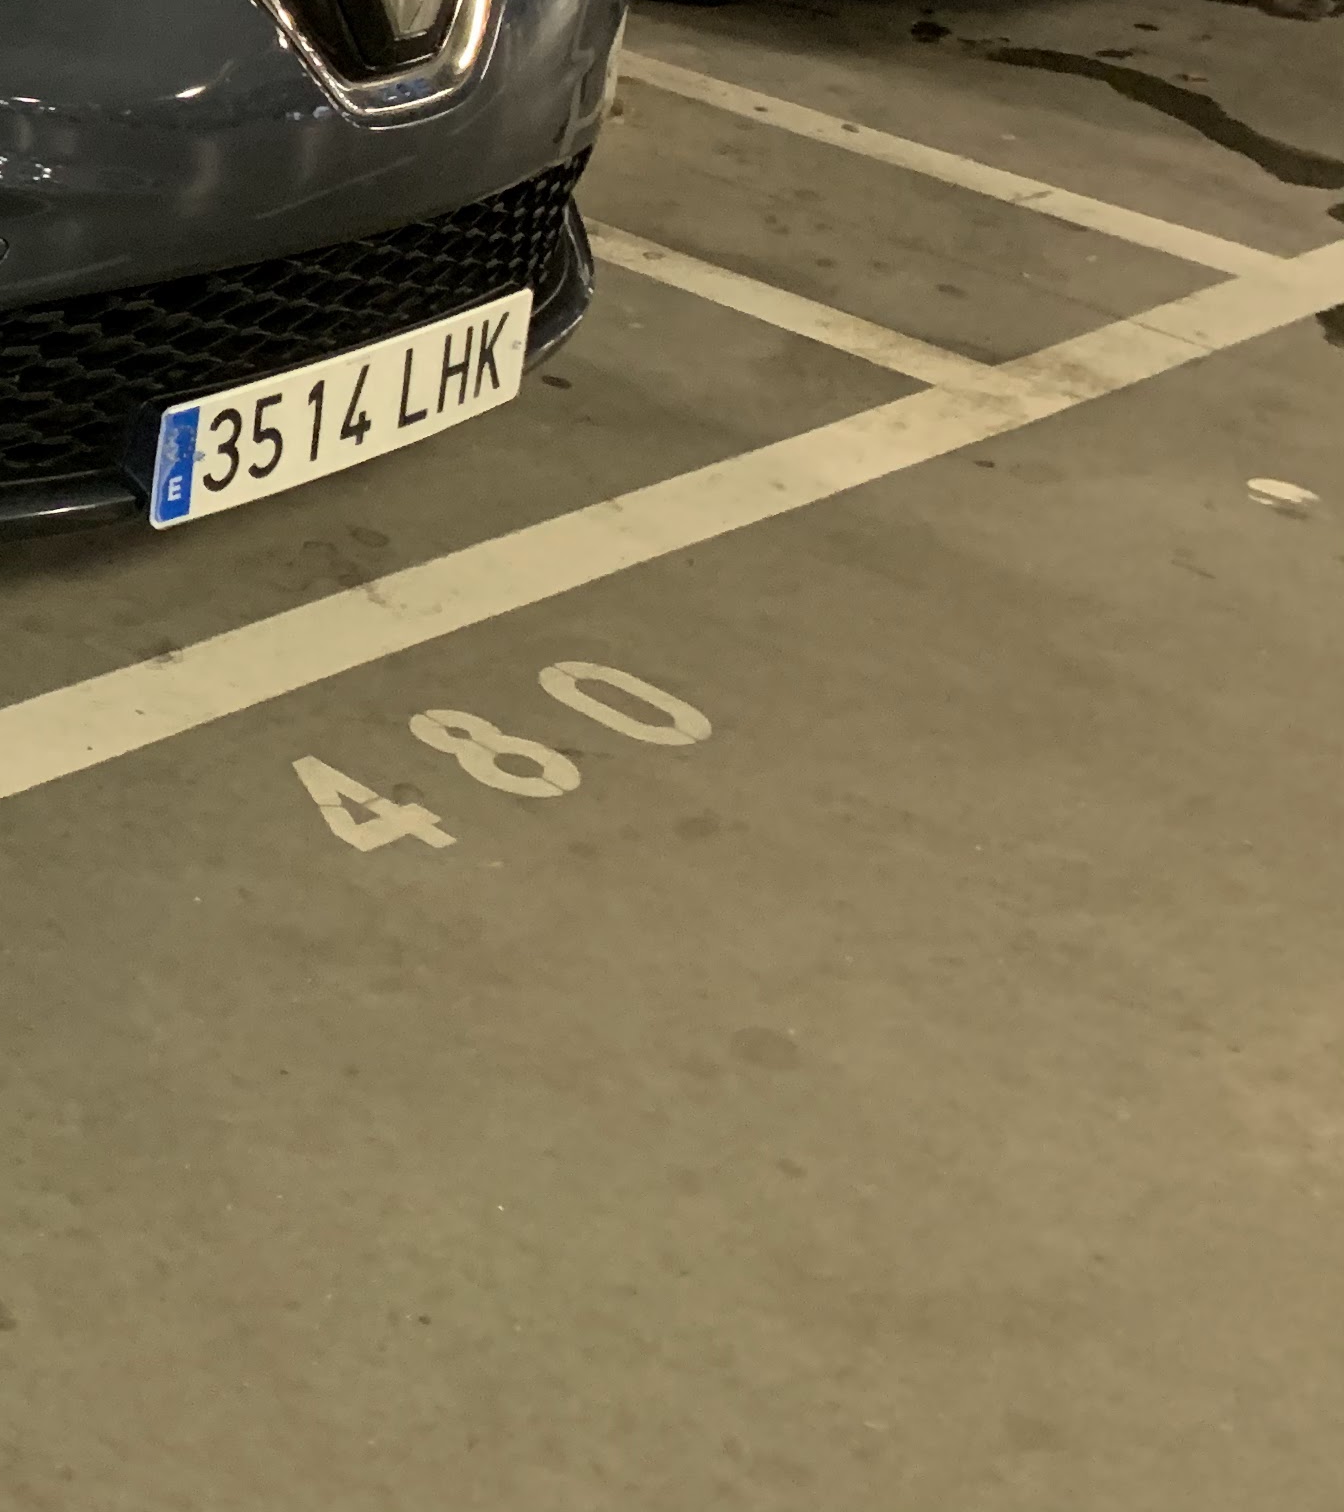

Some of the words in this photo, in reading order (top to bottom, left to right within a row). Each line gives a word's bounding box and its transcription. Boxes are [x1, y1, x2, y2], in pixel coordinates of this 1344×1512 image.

[166, 474, 182, 502] E
[202, 363, 372, 493] 3514
[397, 311, 511, 430] LHK
[291, 660, 712, 852] 480
